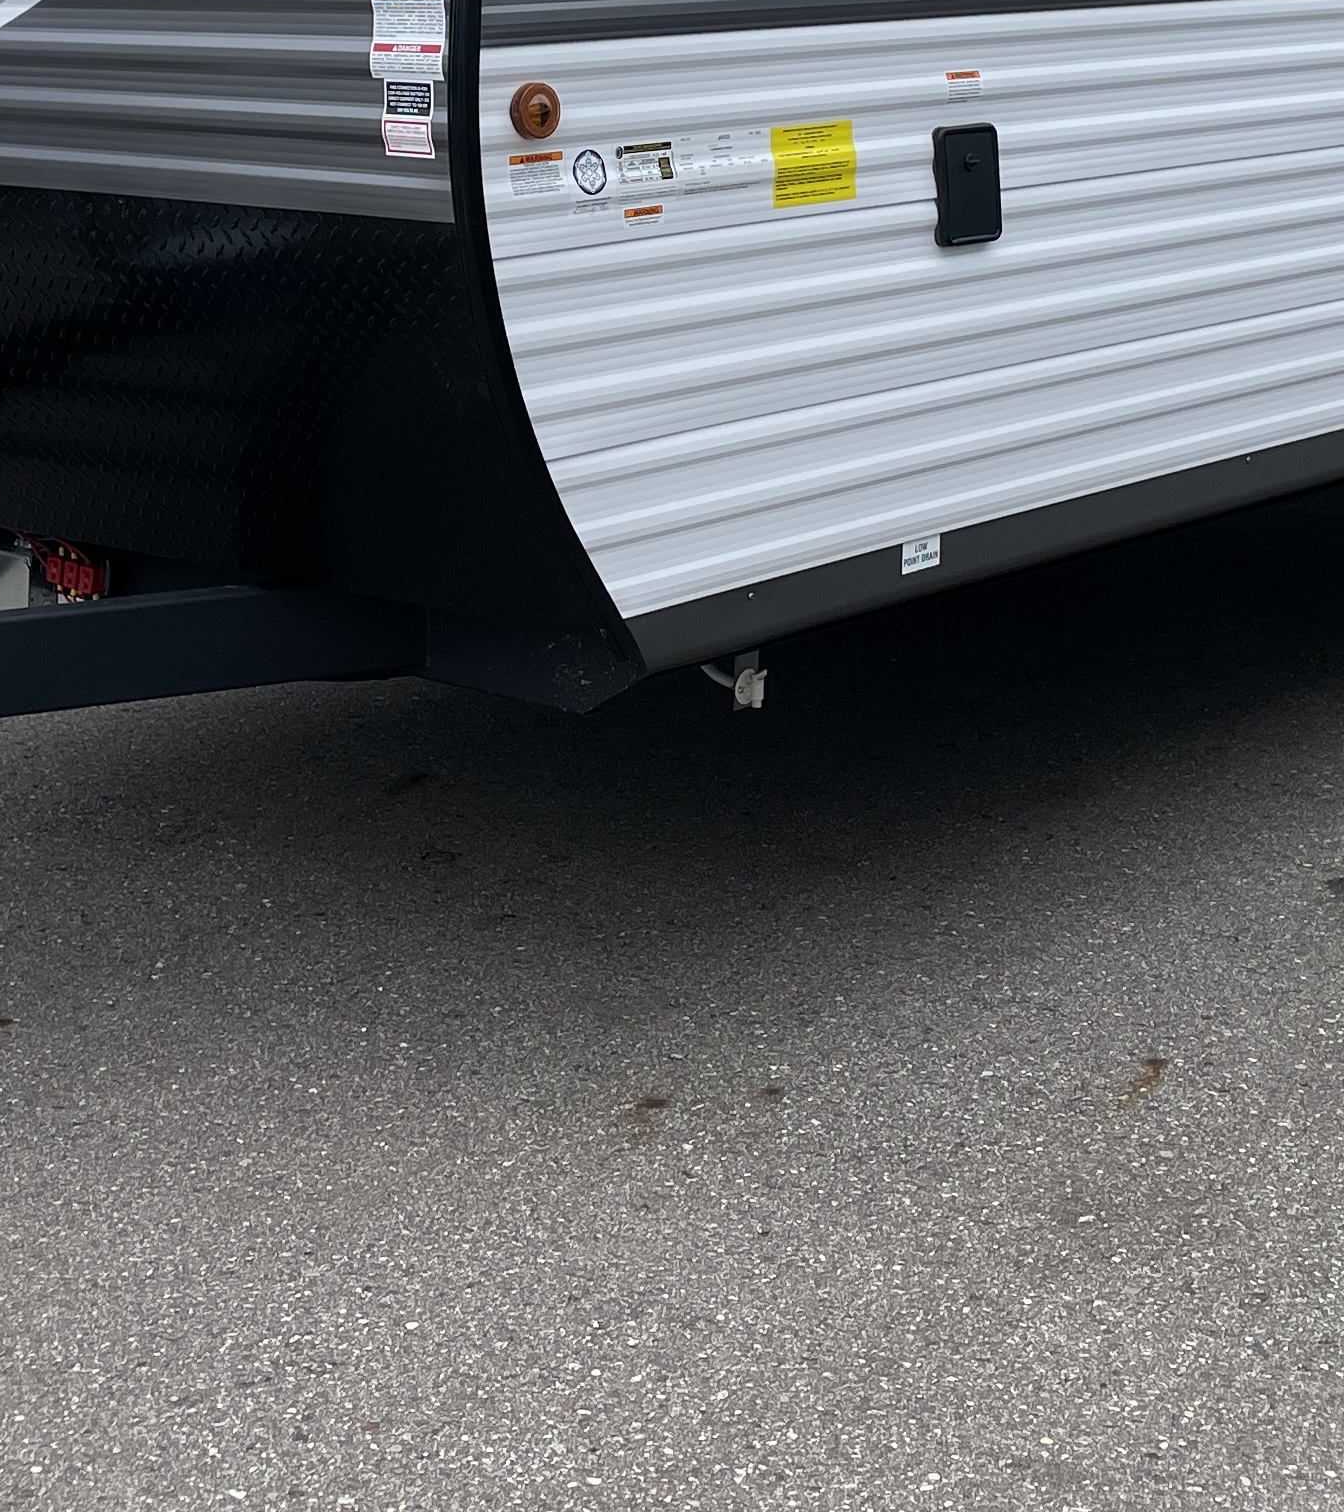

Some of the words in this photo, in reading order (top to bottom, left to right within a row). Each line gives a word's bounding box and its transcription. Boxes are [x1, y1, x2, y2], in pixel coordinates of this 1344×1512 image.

[397, 44, 422, 52] DANGER
[915, 542, 929, 553] LOW
[904, 555, 920, 567] POINT
[921, 550, 938, 562] DRAIN
